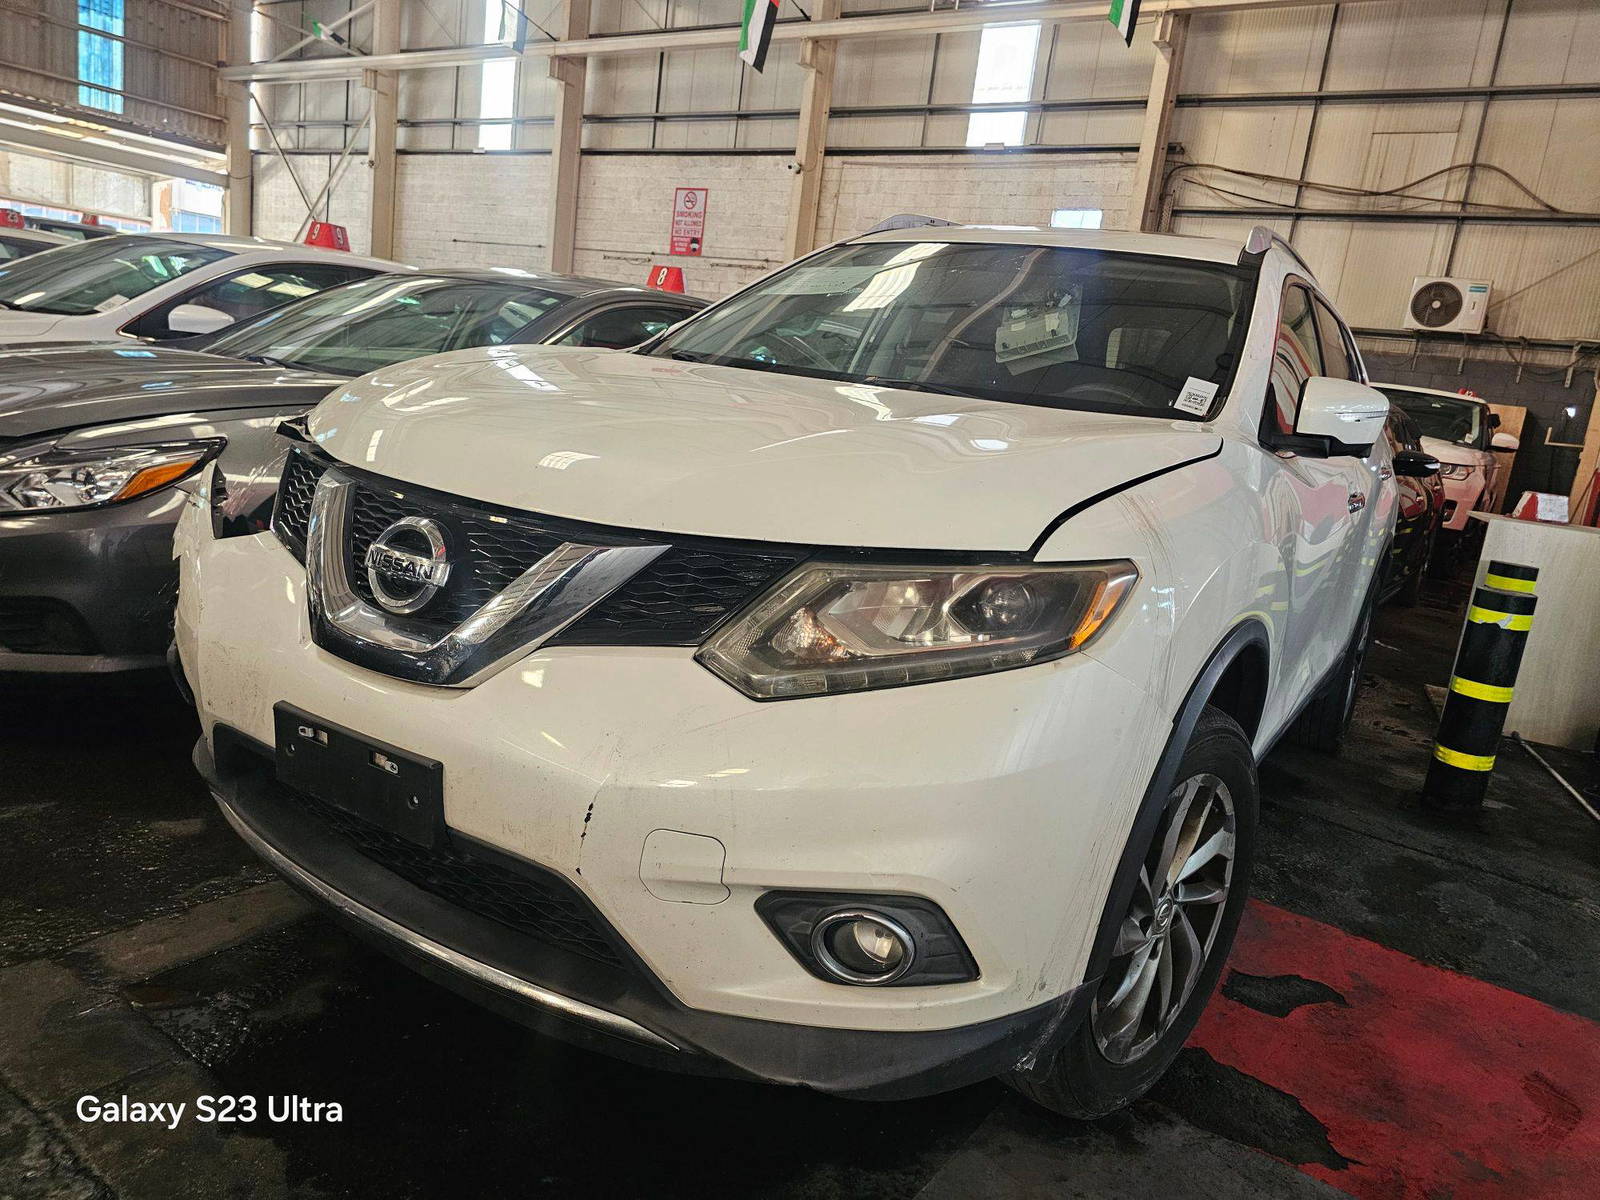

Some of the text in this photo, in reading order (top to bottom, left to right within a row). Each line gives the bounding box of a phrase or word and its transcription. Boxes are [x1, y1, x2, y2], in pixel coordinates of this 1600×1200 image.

[312, 223, 320, 240] 9
[336, 227, 344, 245] 9
[656, 267, 668, 285] 8
[367, 547, 434, 580] NISSAN
